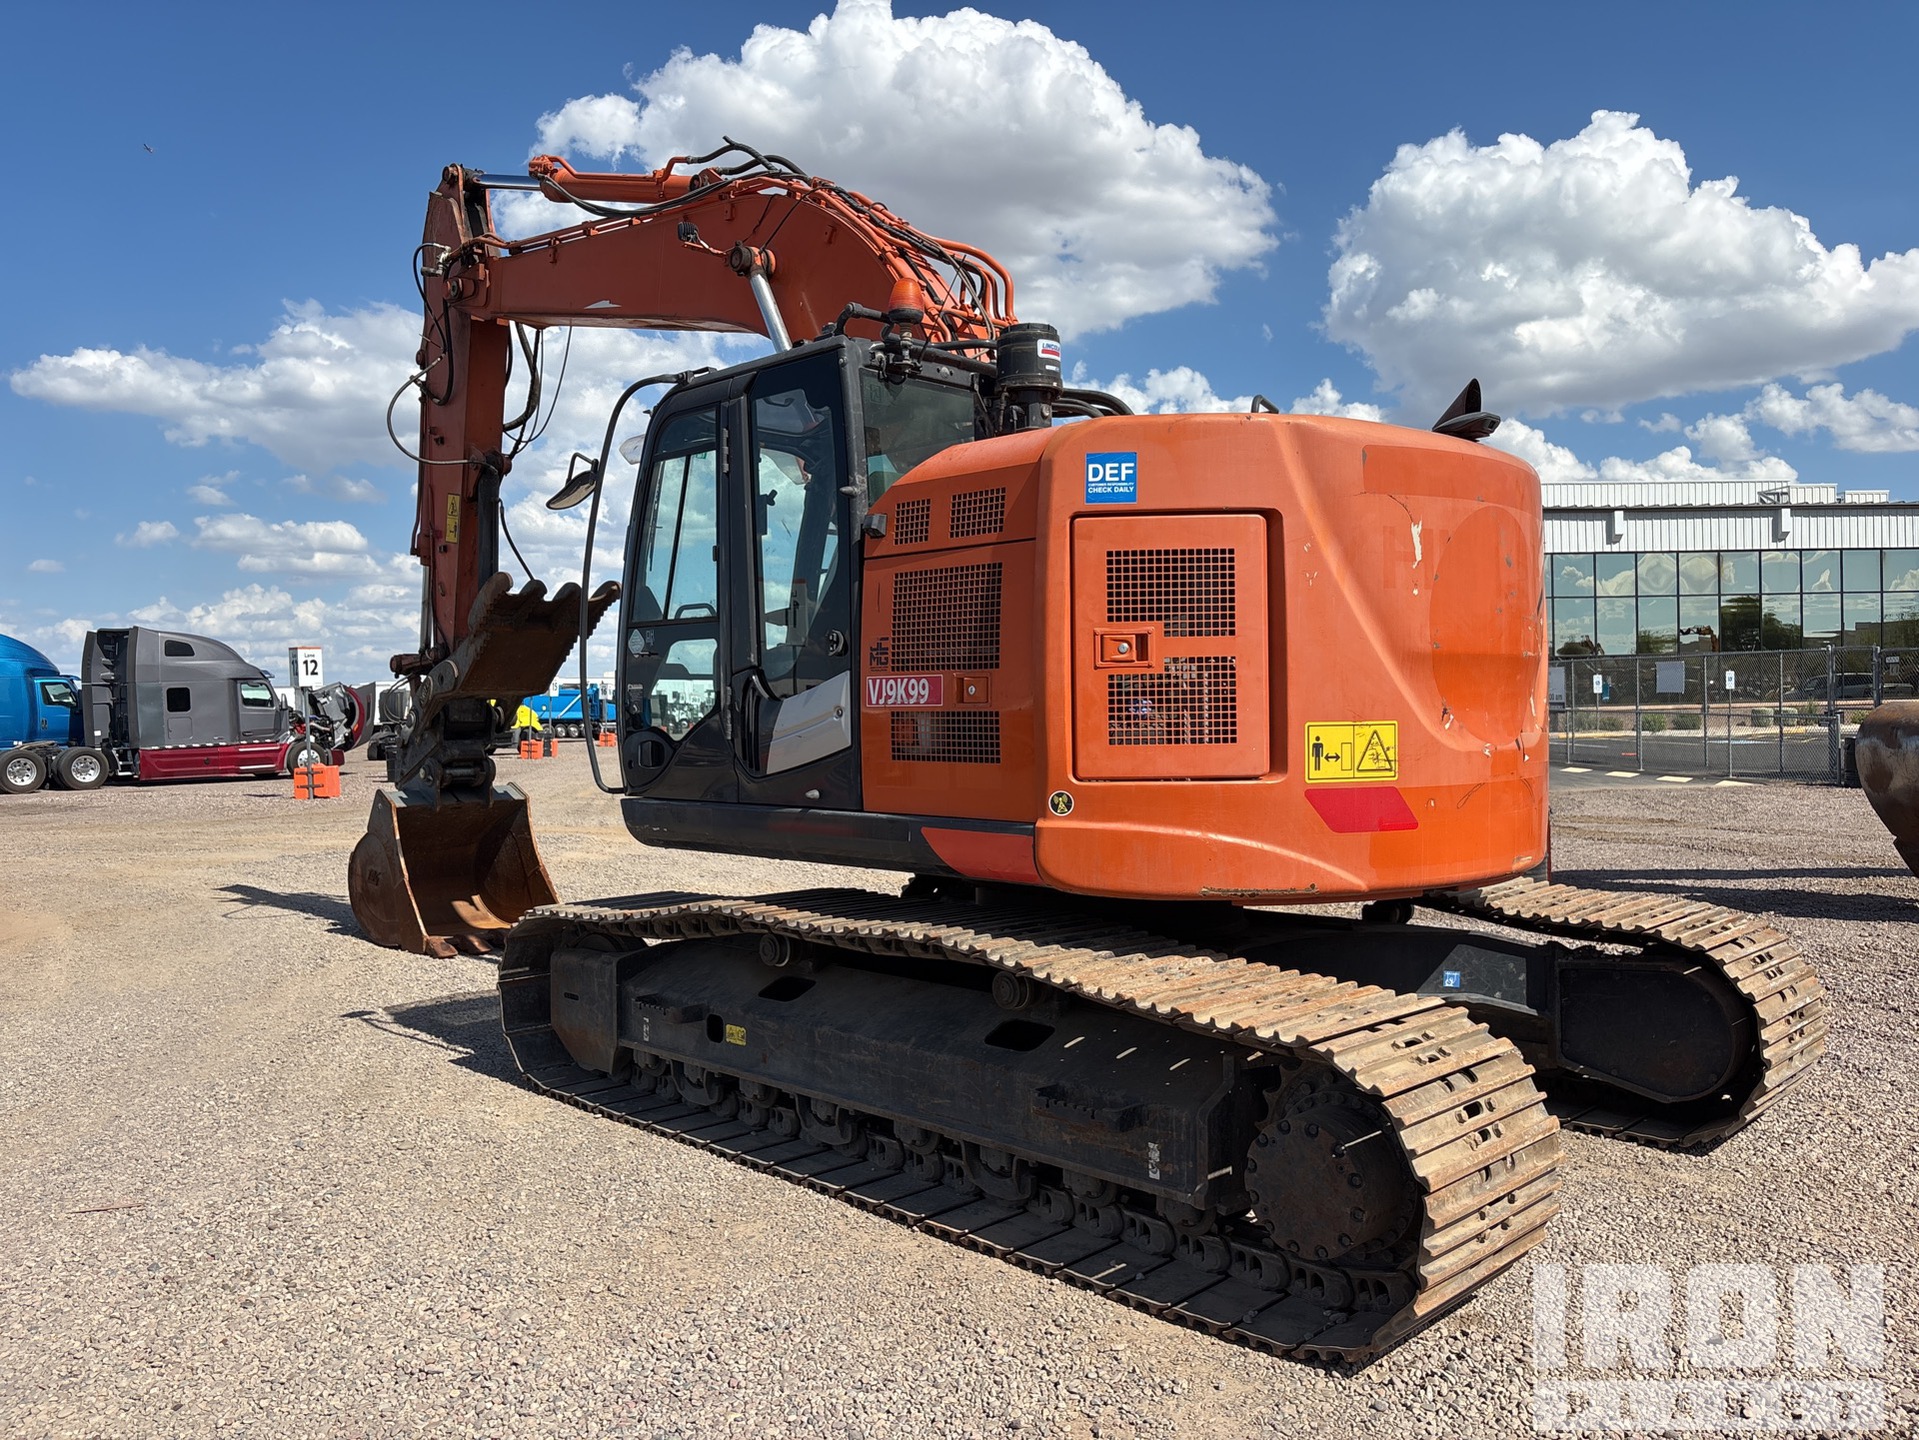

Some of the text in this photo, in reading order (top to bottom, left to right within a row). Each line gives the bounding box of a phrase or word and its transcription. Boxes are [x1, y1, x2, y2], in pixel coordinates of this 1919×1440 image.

[1088, 463, 1134, 482] DEF
[303, 659, 318, 676] 12
[552, 682, 558, 691] 15
[868, 678, 929, 705] VJ9K99
